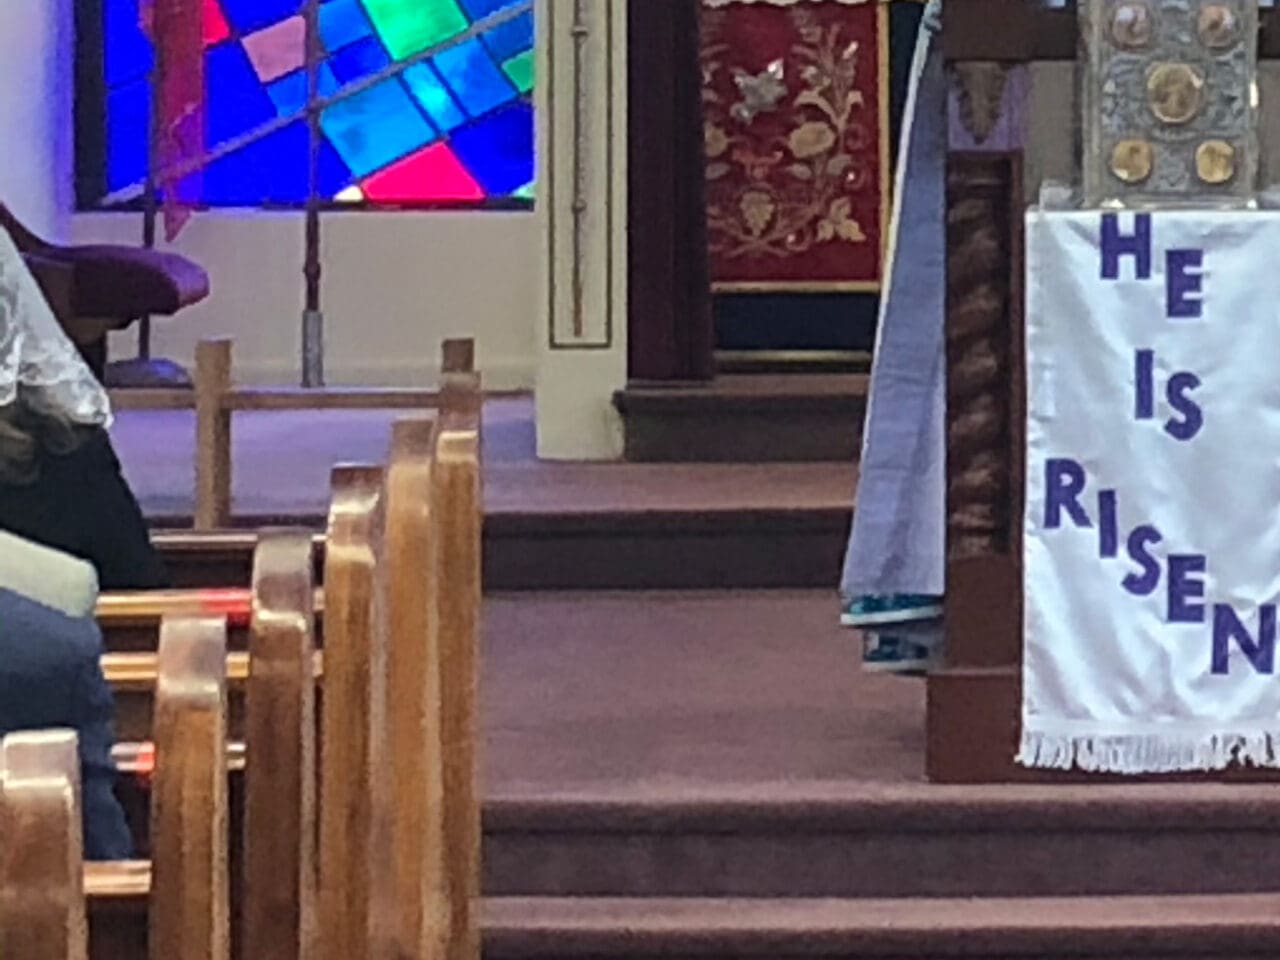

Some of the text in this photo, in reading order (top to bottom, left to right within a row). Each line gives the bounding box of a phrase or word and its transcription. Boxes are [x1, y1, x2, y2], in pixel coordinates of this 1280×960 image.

[1099, 213, 1204, 318] HE
[1134, 349, 1204, 441] IS
[1043, 458, 1277, 675] RISEN
